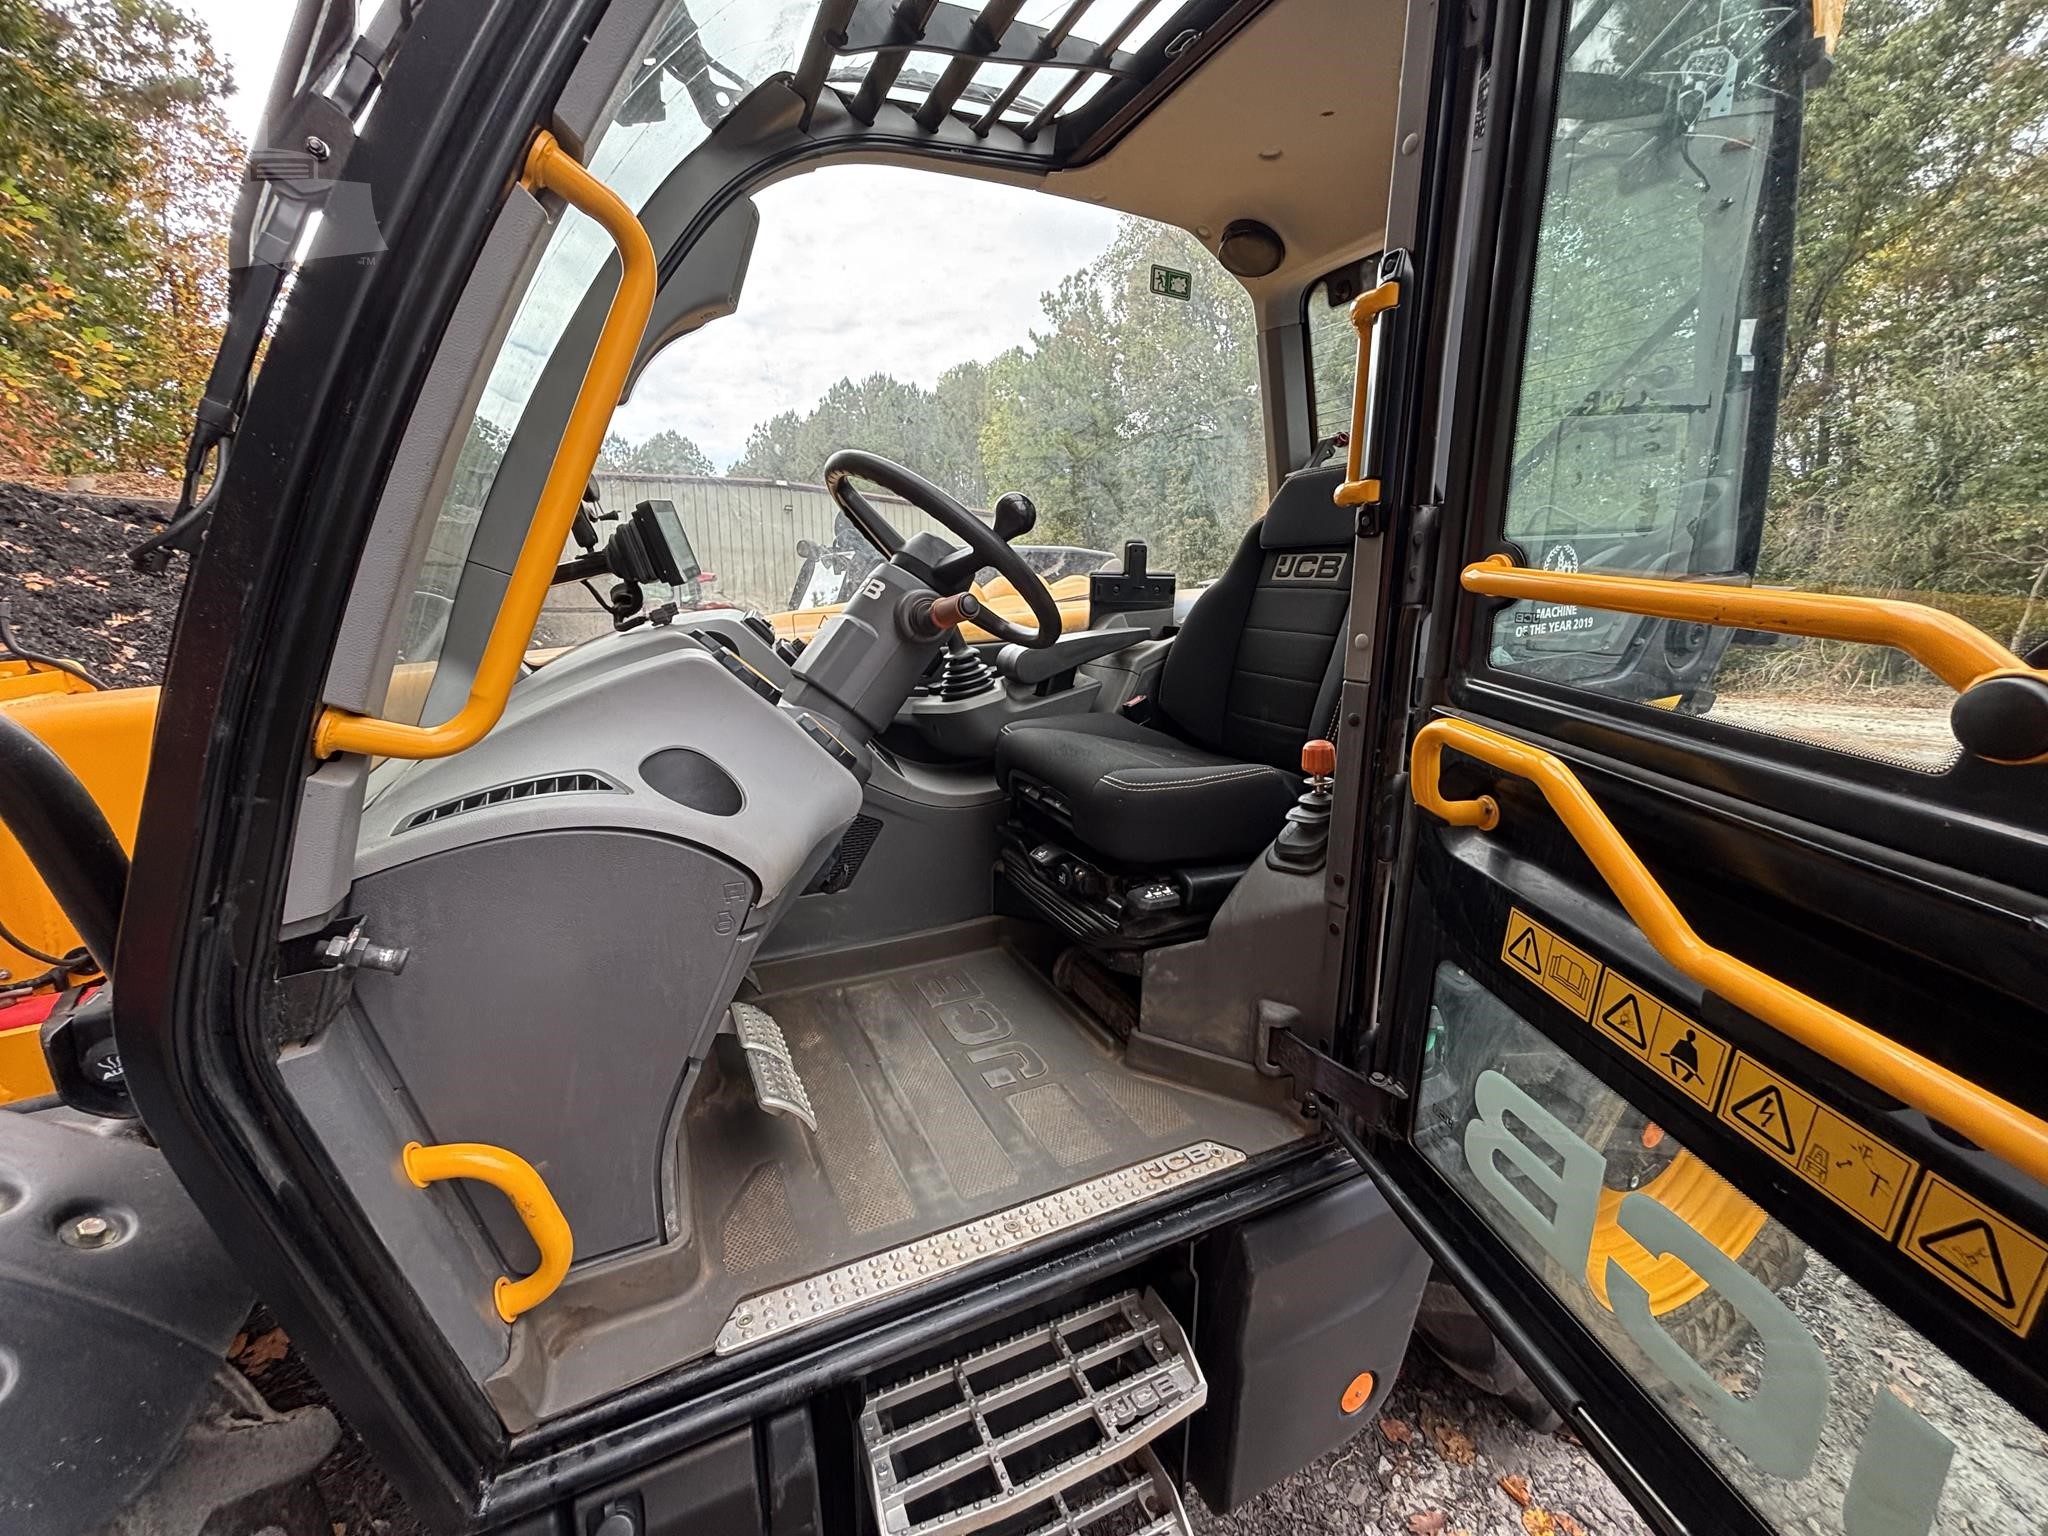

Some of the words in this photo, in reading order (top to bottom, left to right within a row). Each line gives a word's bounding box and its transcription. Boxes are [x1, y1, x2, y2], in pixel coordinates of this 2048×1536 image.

[1275, 555, 1343, 579] JCB
[1536, 605, 1578, 619] MACHINE
[1515, 625, 1529, 638] OF
[1530, 623, 1547, 635] THE
[1548, 619, 1572, 633] YEAR
[1573, 616, 1594, 629] 2019
[1143, 1147, 1213, 1179] JCB
[1104, 1374, 1181, 1424] JCB
